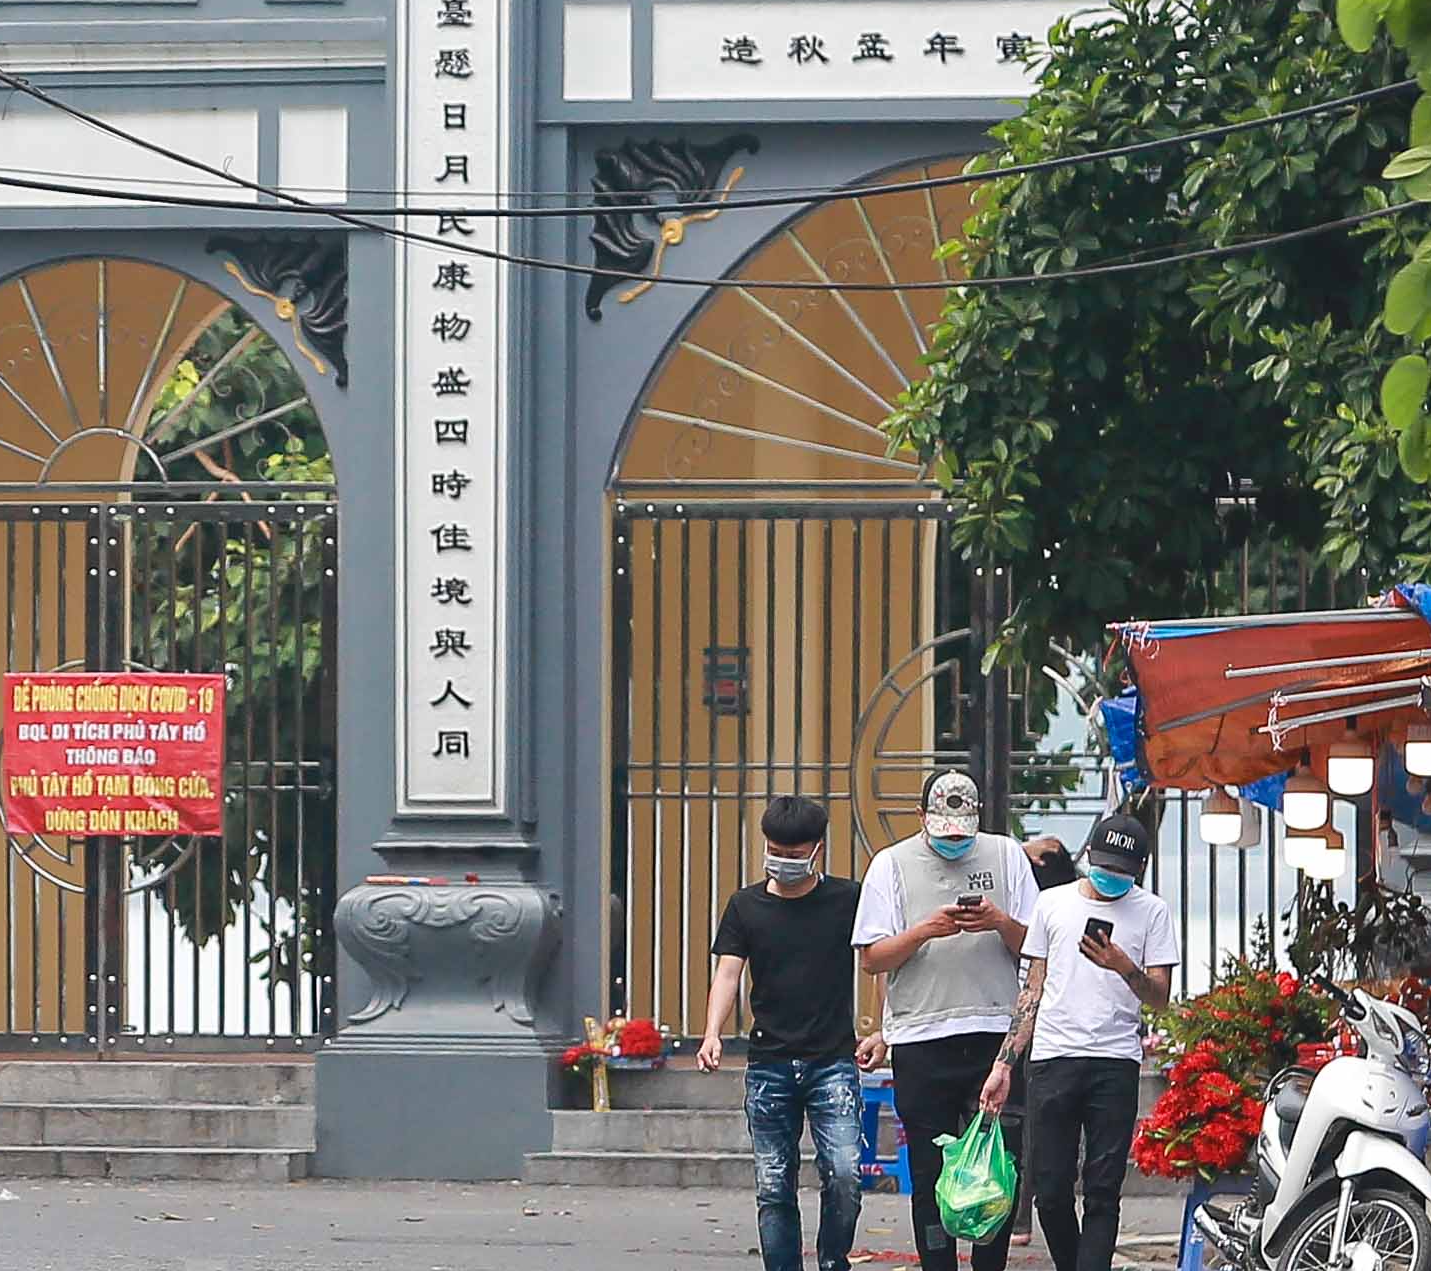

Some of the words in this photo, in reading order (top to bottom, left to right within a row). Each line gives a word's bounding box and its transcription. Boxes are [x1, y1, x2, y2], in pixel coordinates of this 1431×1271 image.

[76, 678, 118, 712] CHỐNG
[119, 685, 148, 719] DỊCH
[150, 686, 187, 712] COVID
[198, 687, 214, 714] 19
[72, 720, 109, 740] TÍCH
[113, 719, 145, 740] PHỦ
[149, 720, 180, 740] TÂY
[66, 745, 118, 765] THÔNG
[122, 745, 156, 765] BÁO
[10, 769, 38, 797] PHỦ
[42, 771, 69, 797] TÂY
[97, 774, 130, 801] TẠM
[124, 808, 179, 831] KHÁCH
[1105, 830, 1135, 851] DIOR
